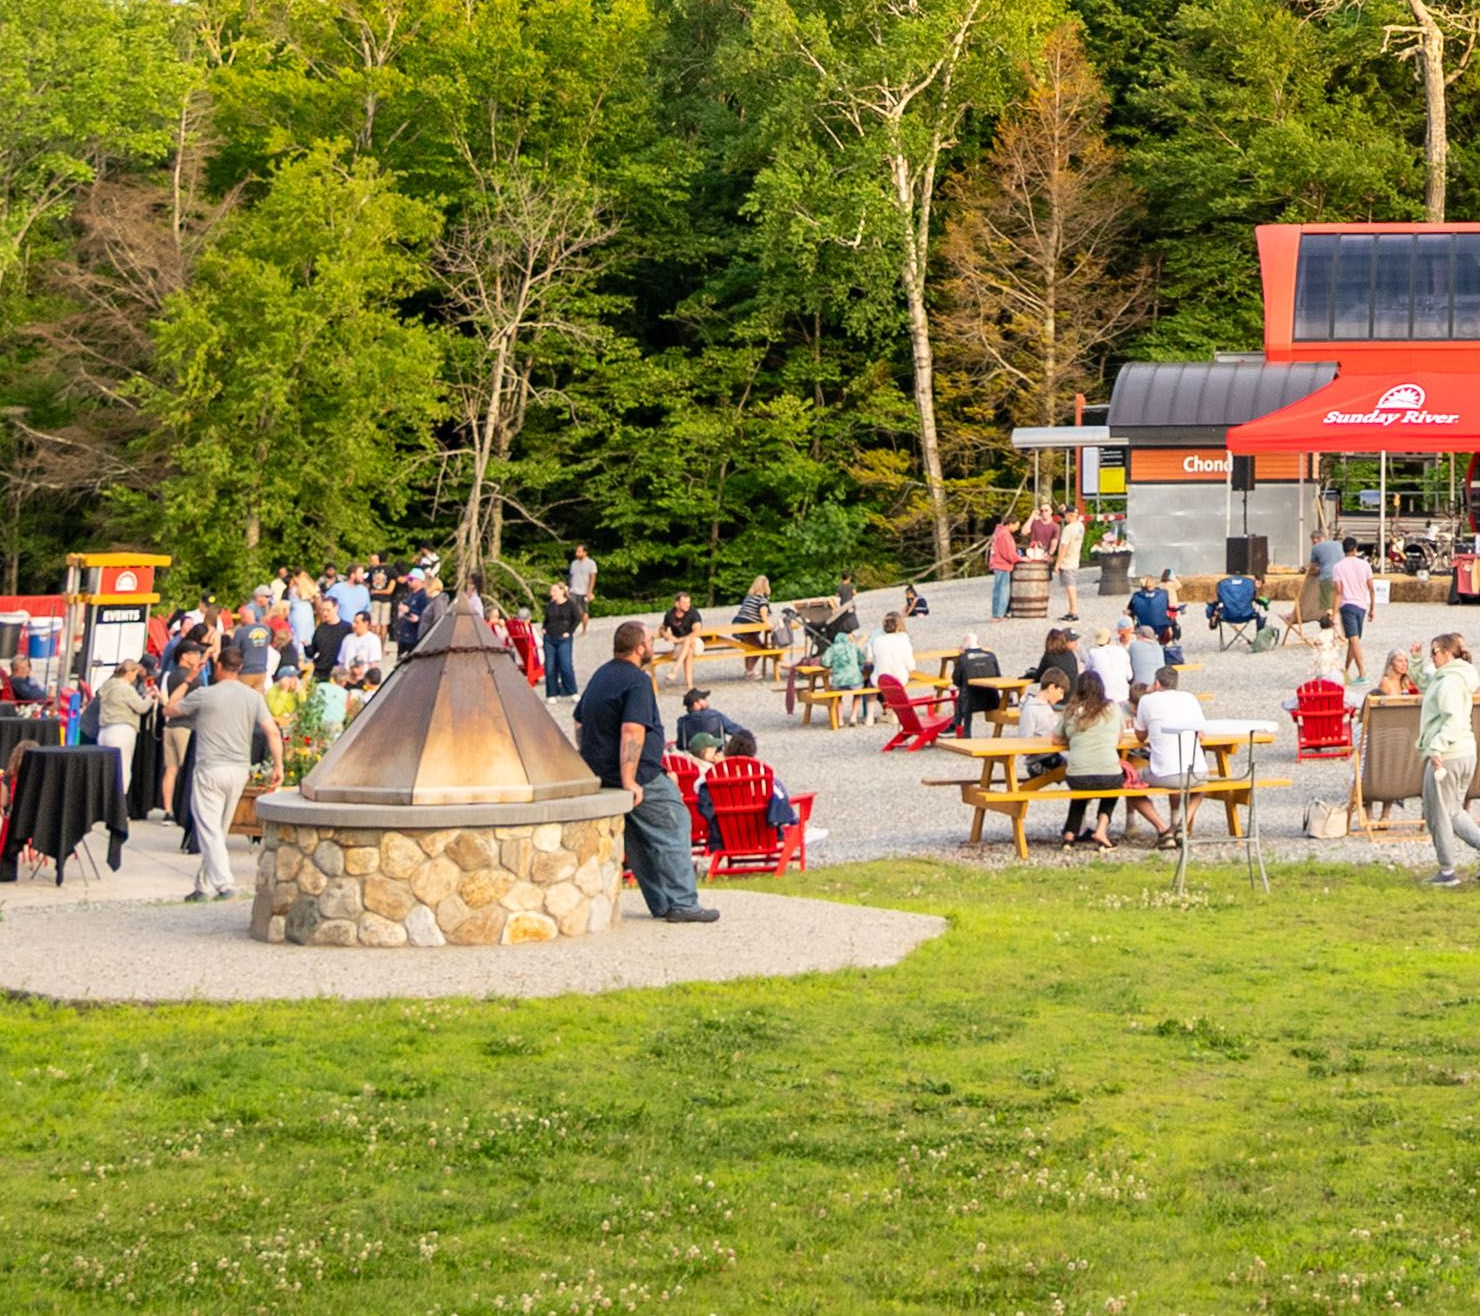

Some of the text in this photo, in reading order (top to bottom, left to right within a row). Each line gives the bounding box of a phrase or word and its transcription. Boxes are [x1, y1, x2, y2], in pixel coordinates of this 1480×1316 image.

[1323, 409, 1457, 426] Sunday River
[1183, 450, 1233, 472] Chond
[103, 609, 140, 622] EVENTS
